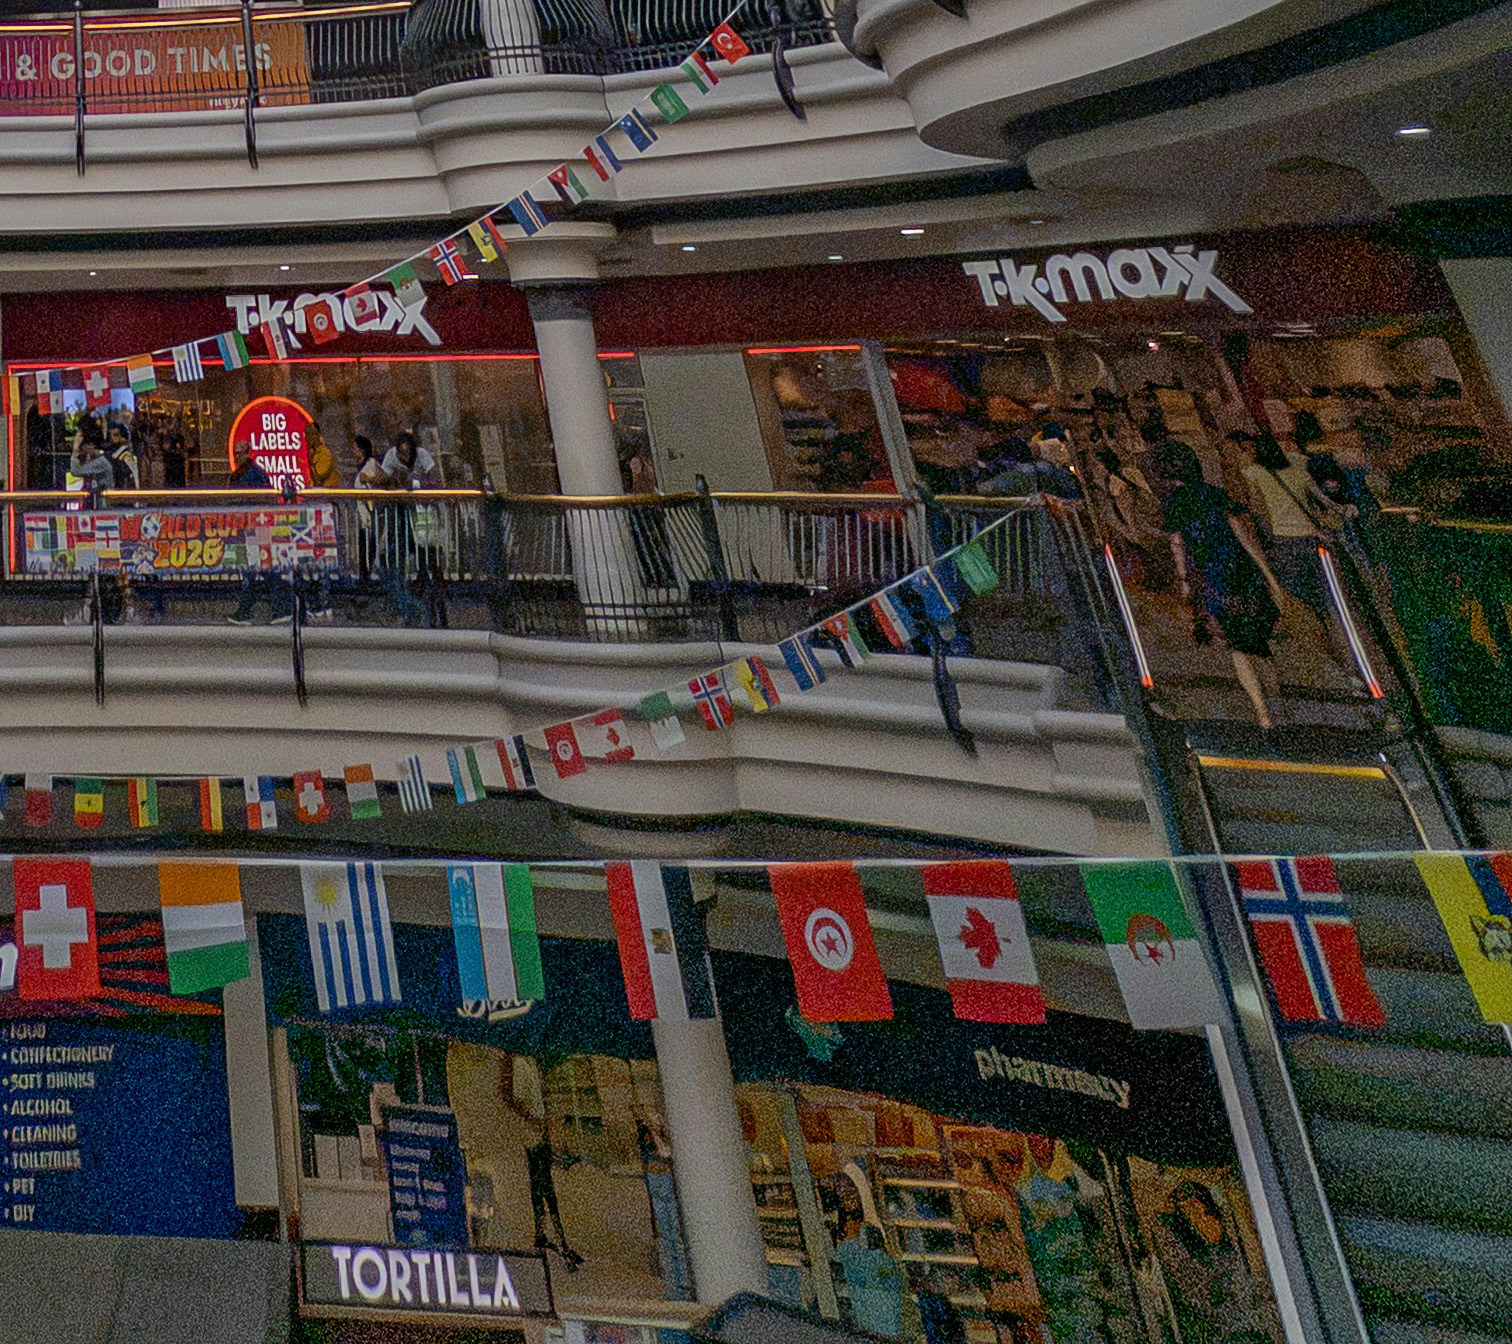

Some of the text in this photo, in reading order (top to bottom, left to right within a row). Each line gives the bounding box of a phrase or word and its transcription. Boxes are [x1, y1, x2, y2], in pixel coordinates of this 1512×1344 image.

[15, 54, 38, 82] &
[50, 49, 156, 81] GOOD
[167, 43, 273, 75] TIMES
[261, 413, 287, 432] BIG
[250, 431, 302, 451] LABELS
[255, 455, 302, 474] SMALL
[153, 538, 225, 569] 2026
[973, 1045, 1131, 1109] pharmacy
[11, 1098, 74, 1116] ALCOHOL
[11, 1124, 78, 1143] CLEANING
[11, 1149, 82, 1170] TOILETRIES
[12, 1178, 35, 1195] PET
[13, 1204, 36, 1222] DIY
[331, 1246, 520, 1310] TORTILLA
